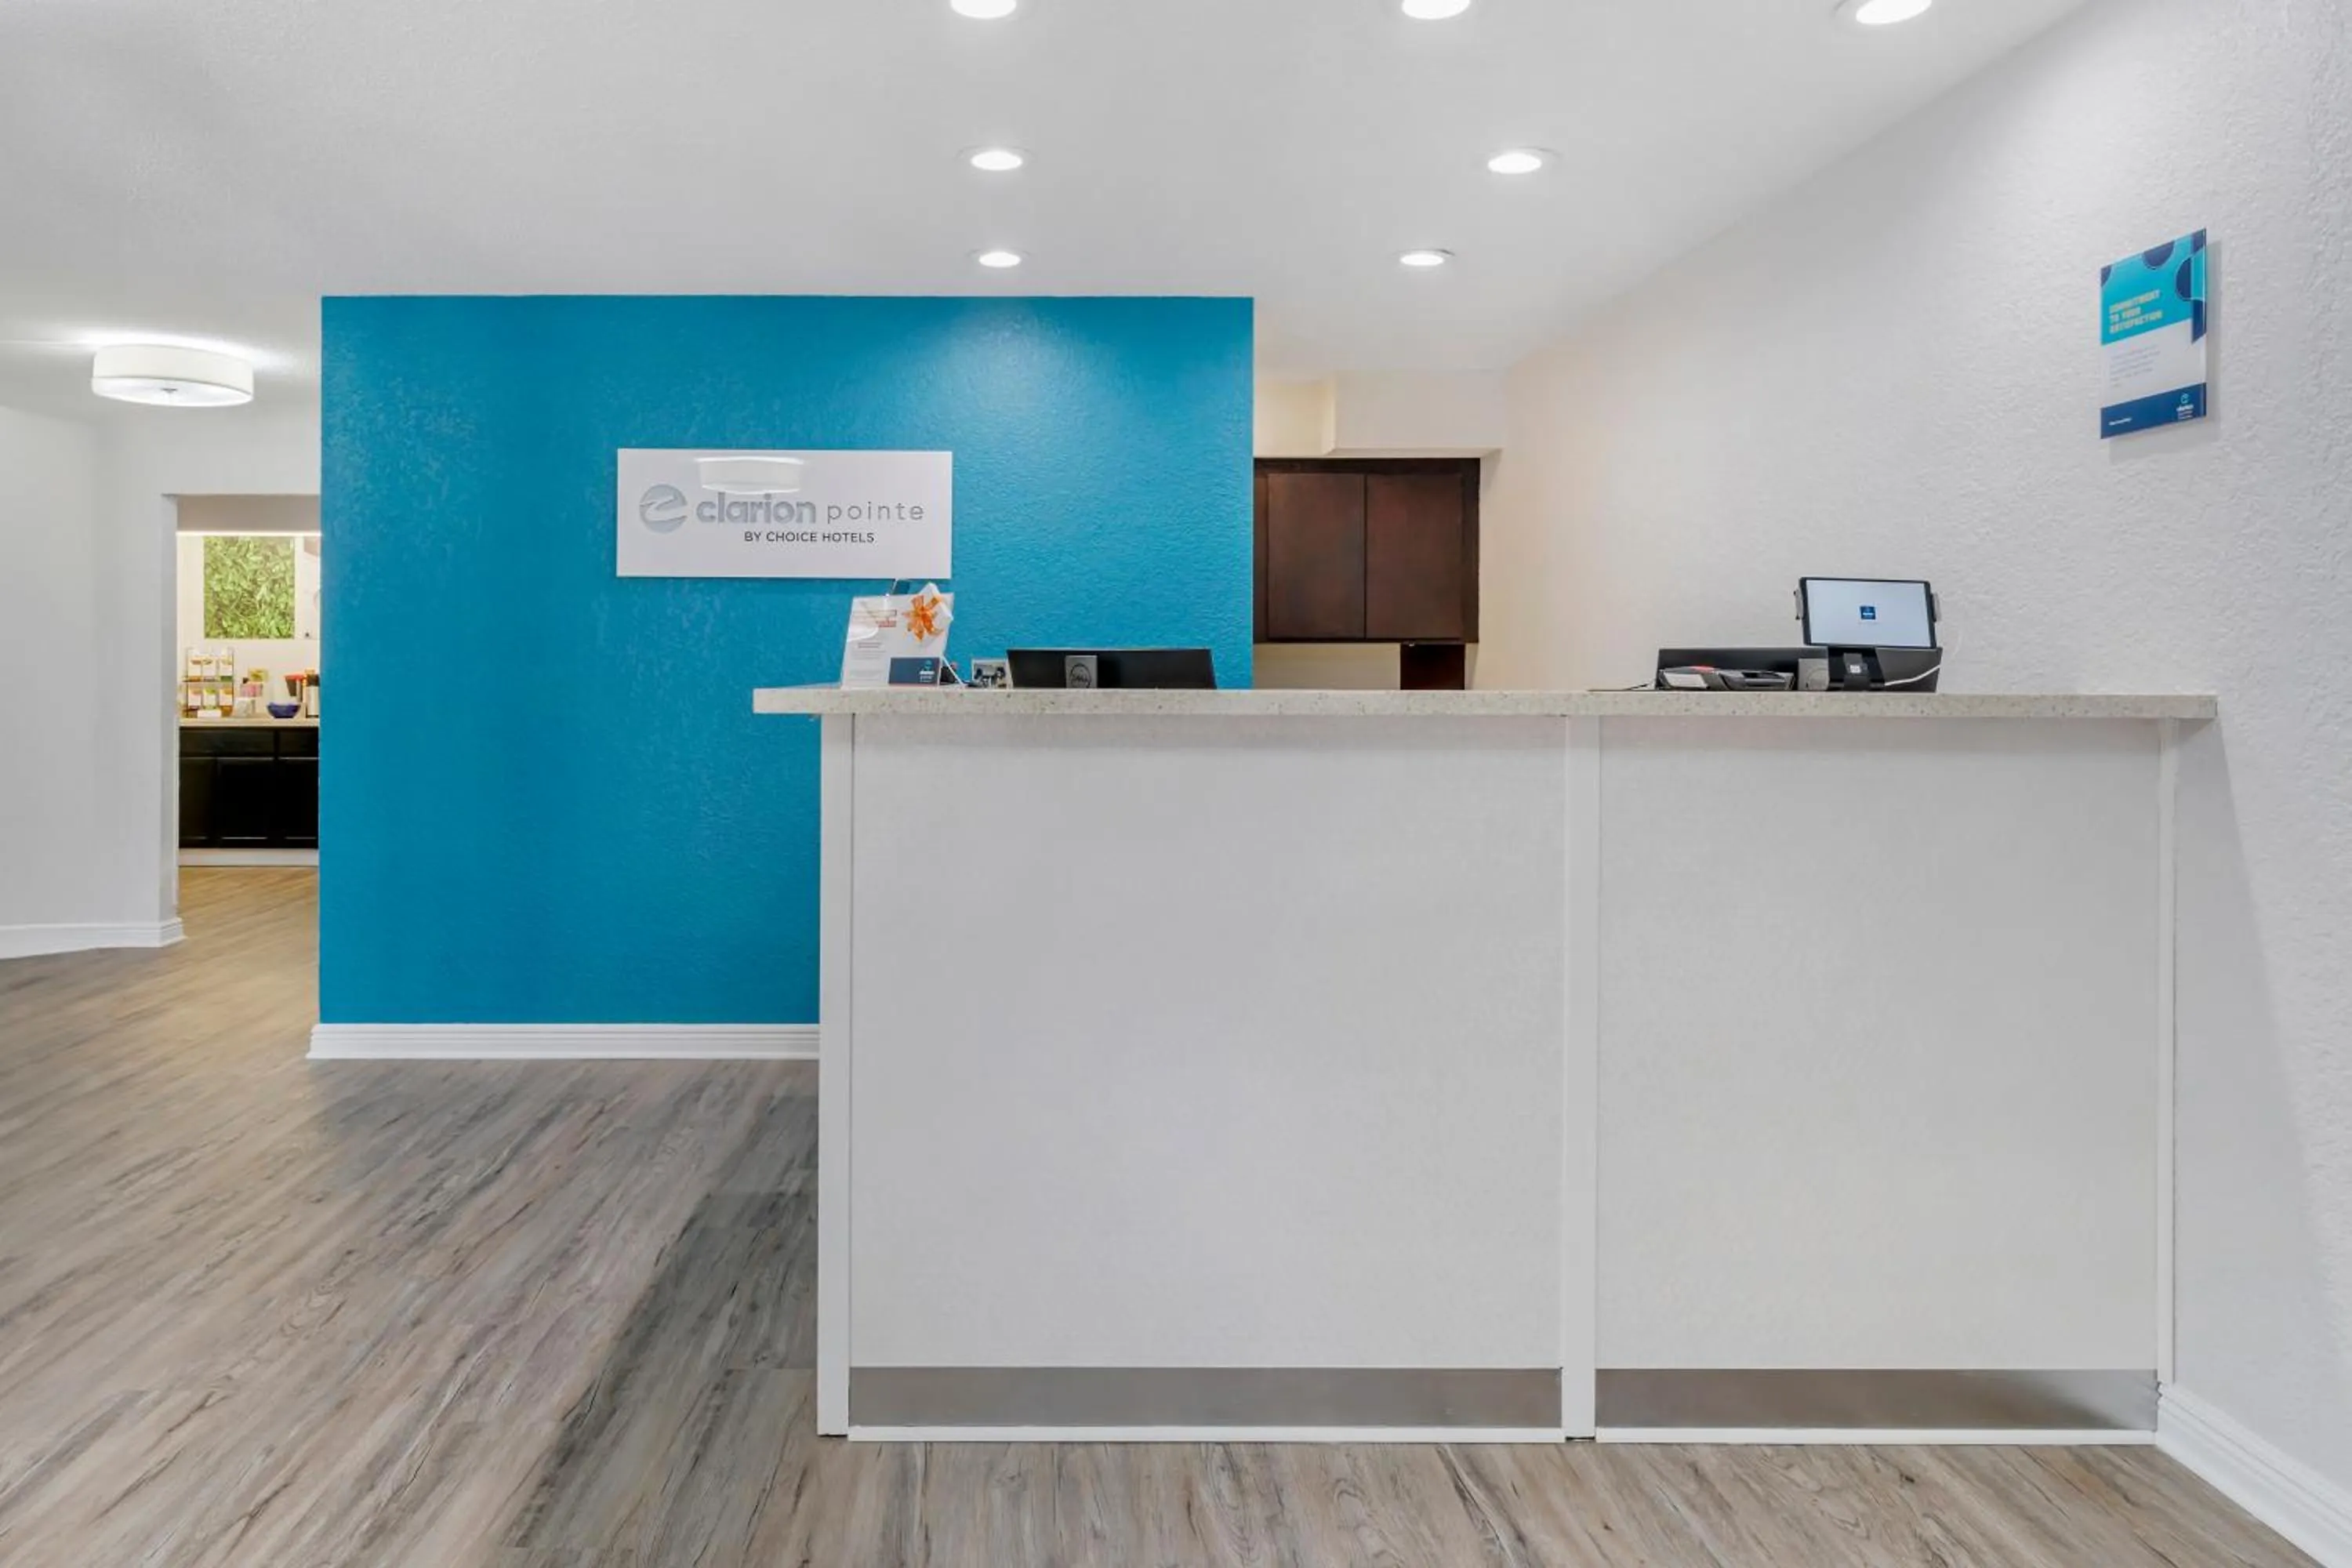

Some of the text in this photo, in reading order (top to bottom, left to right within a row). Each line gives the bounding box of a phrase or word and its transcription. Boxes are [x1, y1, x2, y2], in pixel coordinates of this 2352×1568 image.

[696, 492, 924, 524] clarion pointe
[744, 531, 875, 543] BY CHOICE HOTELS
